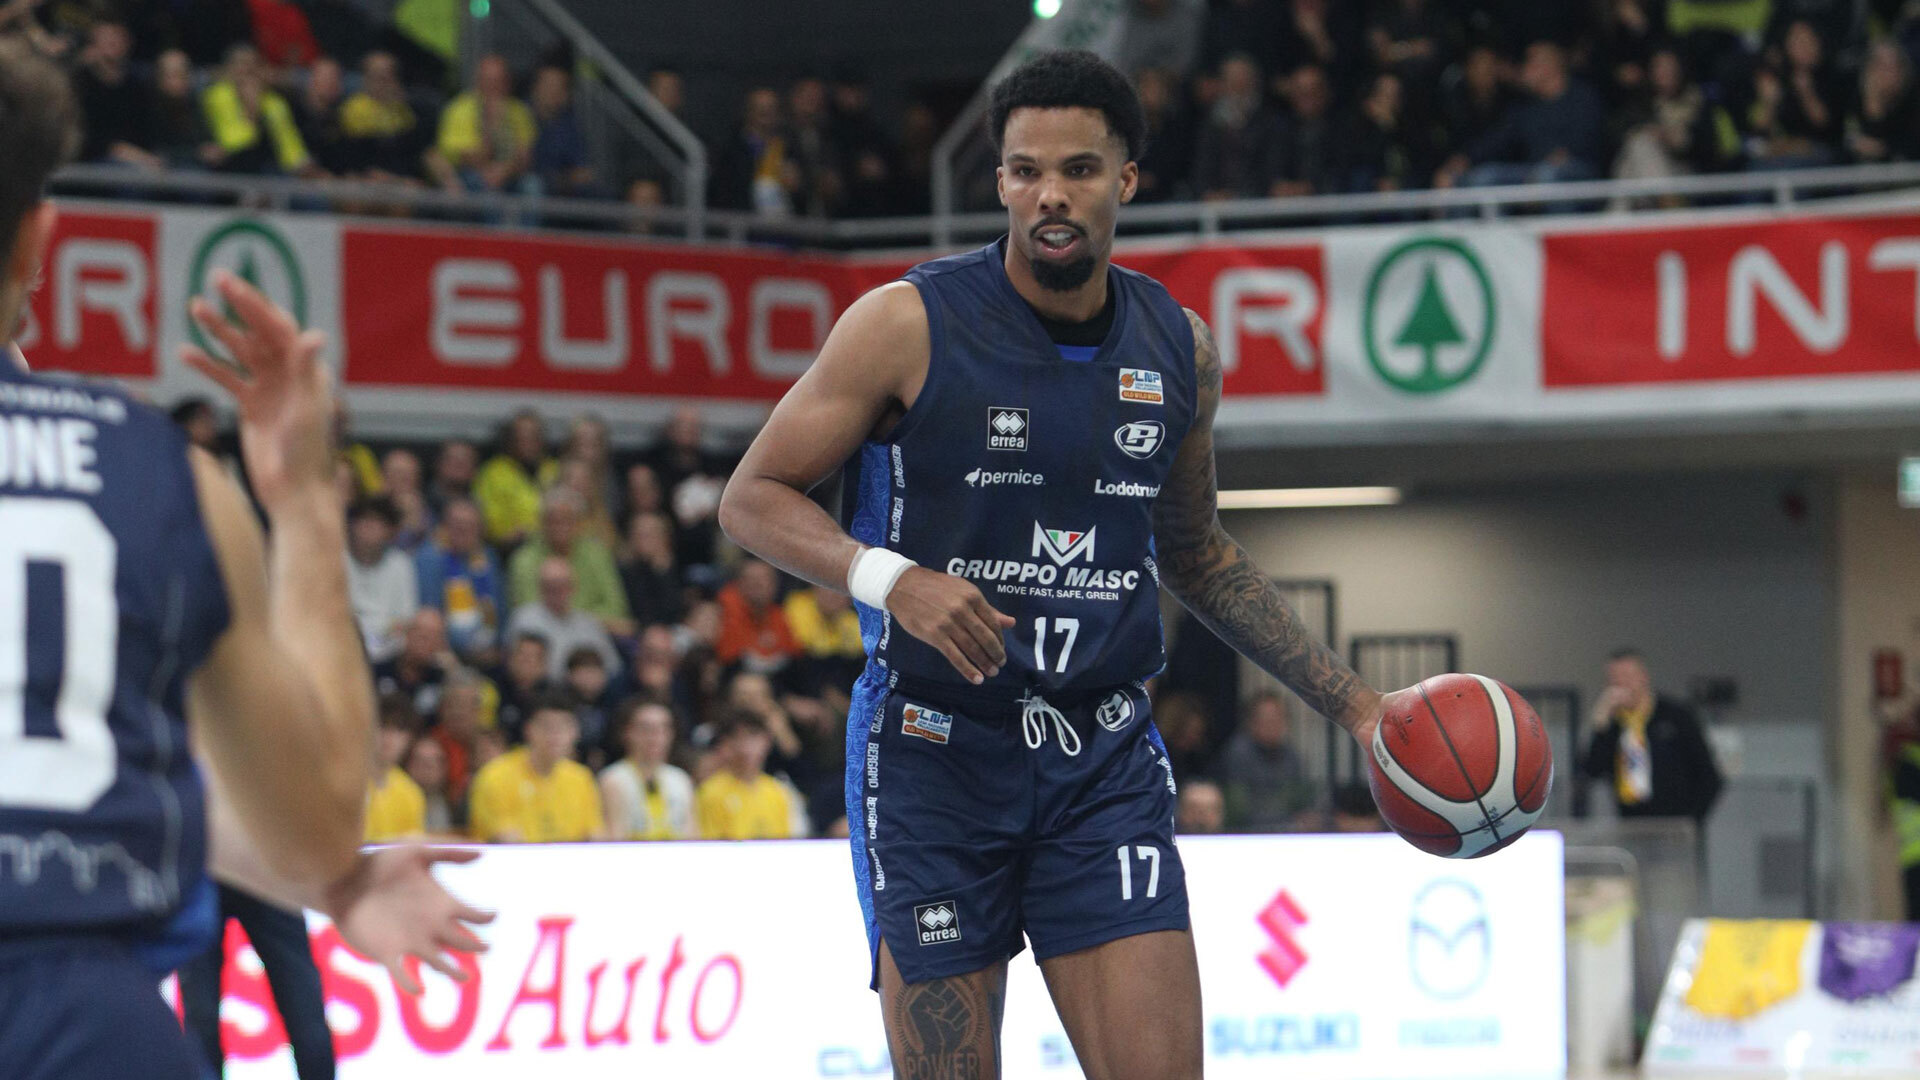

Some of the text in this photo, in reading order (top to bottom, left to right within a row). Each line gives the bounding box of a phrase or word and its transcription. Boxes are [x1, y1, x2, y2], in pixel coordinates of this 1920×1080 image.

[1135, 370, 1160, 383] LNP
[0, 414, 104, 496] NE
[991, 435, 1024, 448] errea
[892, 444, 906, 489] BERGAMO
[981, 469, 1044, 488] pernice
[890, 496, 904, 544] BERGAMO
[946, 557, 1140, 591] GRUPPO MASC
[997, 584, 1119, 600] MOVE FAST, SAFE, GREEN
[1034, 616, 1080, 673] 17
[918, 708, 952, 725] LNP
[867, 742, 879, 789] BERGAMO
[866, 796, 878, 840] BERGAMO
[868, 847, 885, 891] BERGAMO
[1117, 845, 1160, 900] 17
[922, 928, 958, 942] errea
